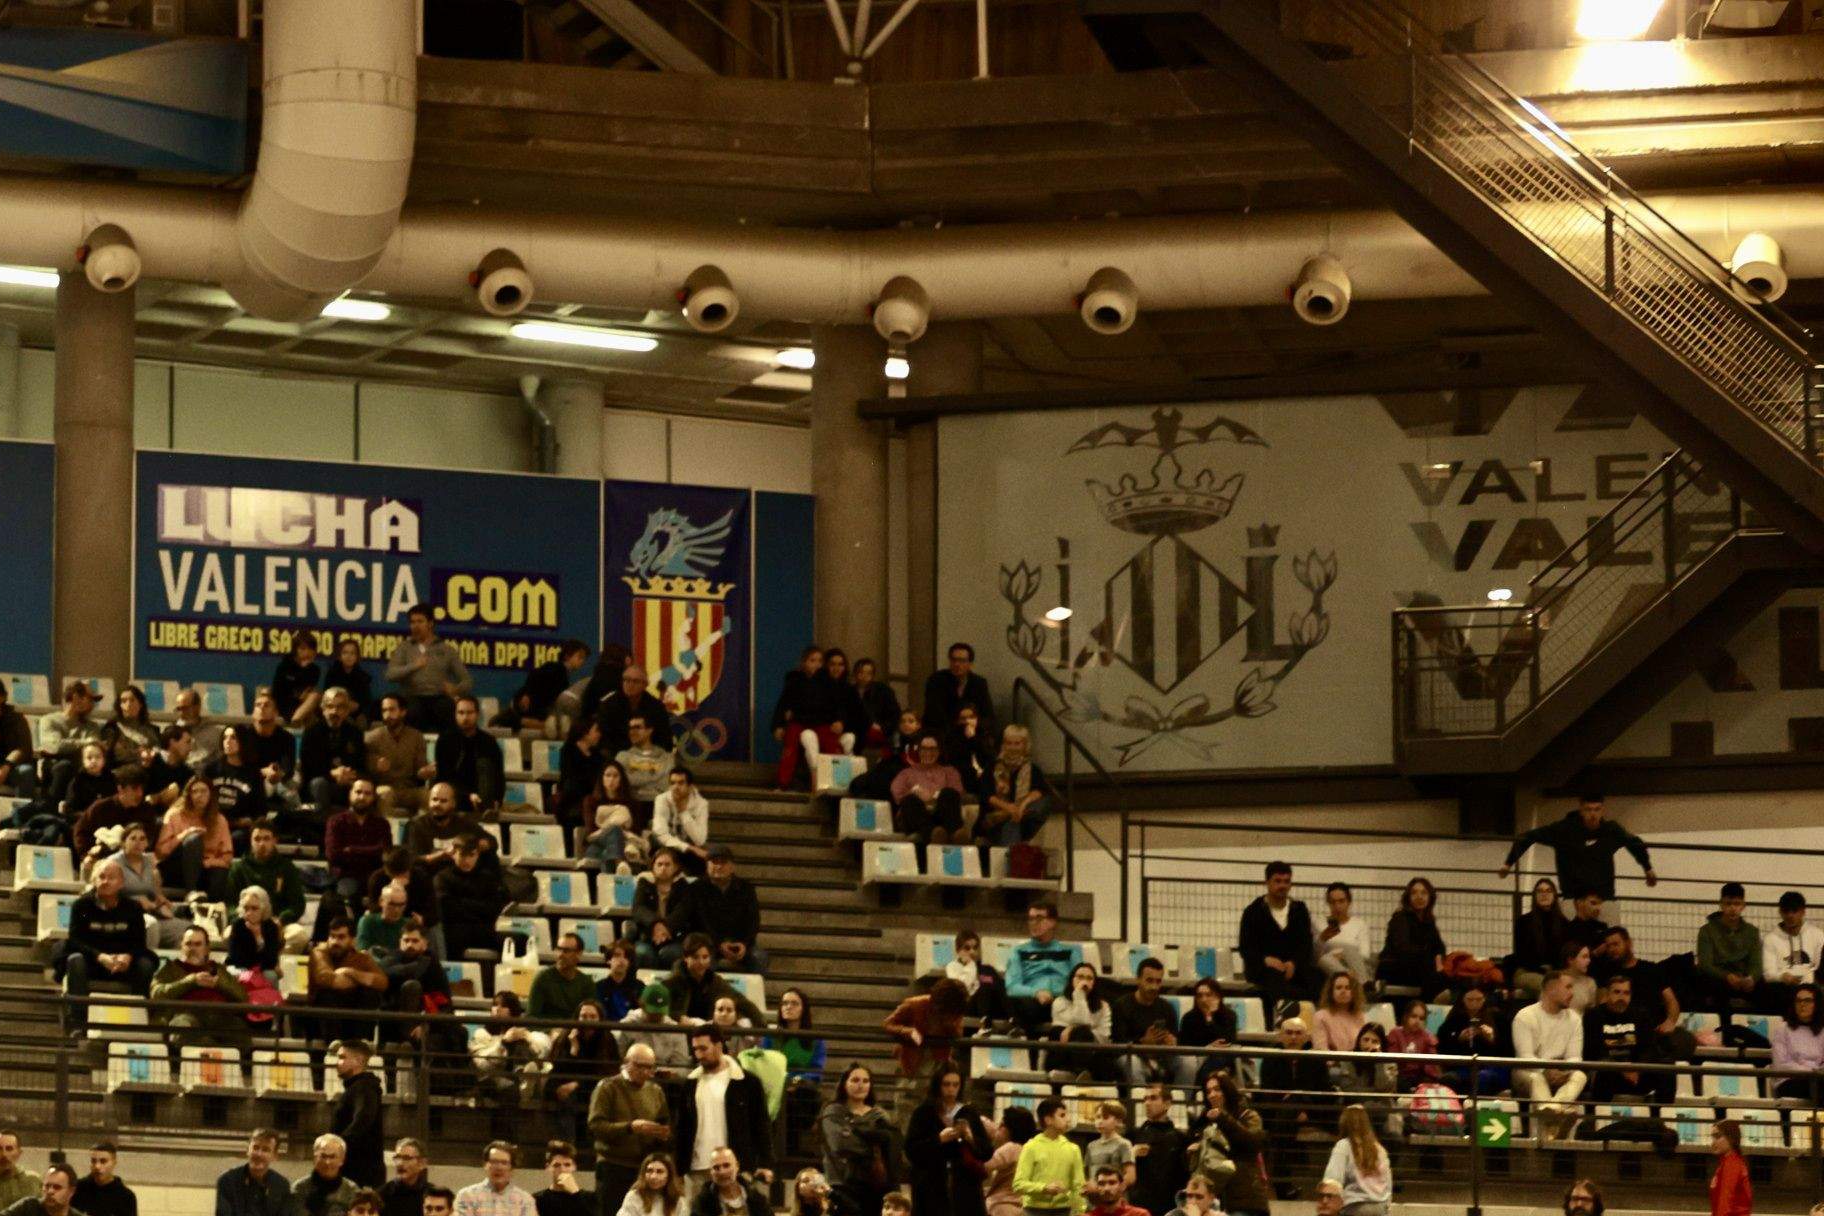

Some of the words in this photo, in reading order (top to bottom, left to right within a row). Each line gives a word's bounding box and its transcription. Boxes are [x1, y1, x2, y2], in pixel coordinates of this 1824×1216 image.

[161, 486, 422, 553] LUCHA
[158, 549, 420, 624] VALENCIA
[149, 621, 200, 650] LIBRE
[204, 625, 263, 653] GRECO
[269, 628, 334, 657] SAO
